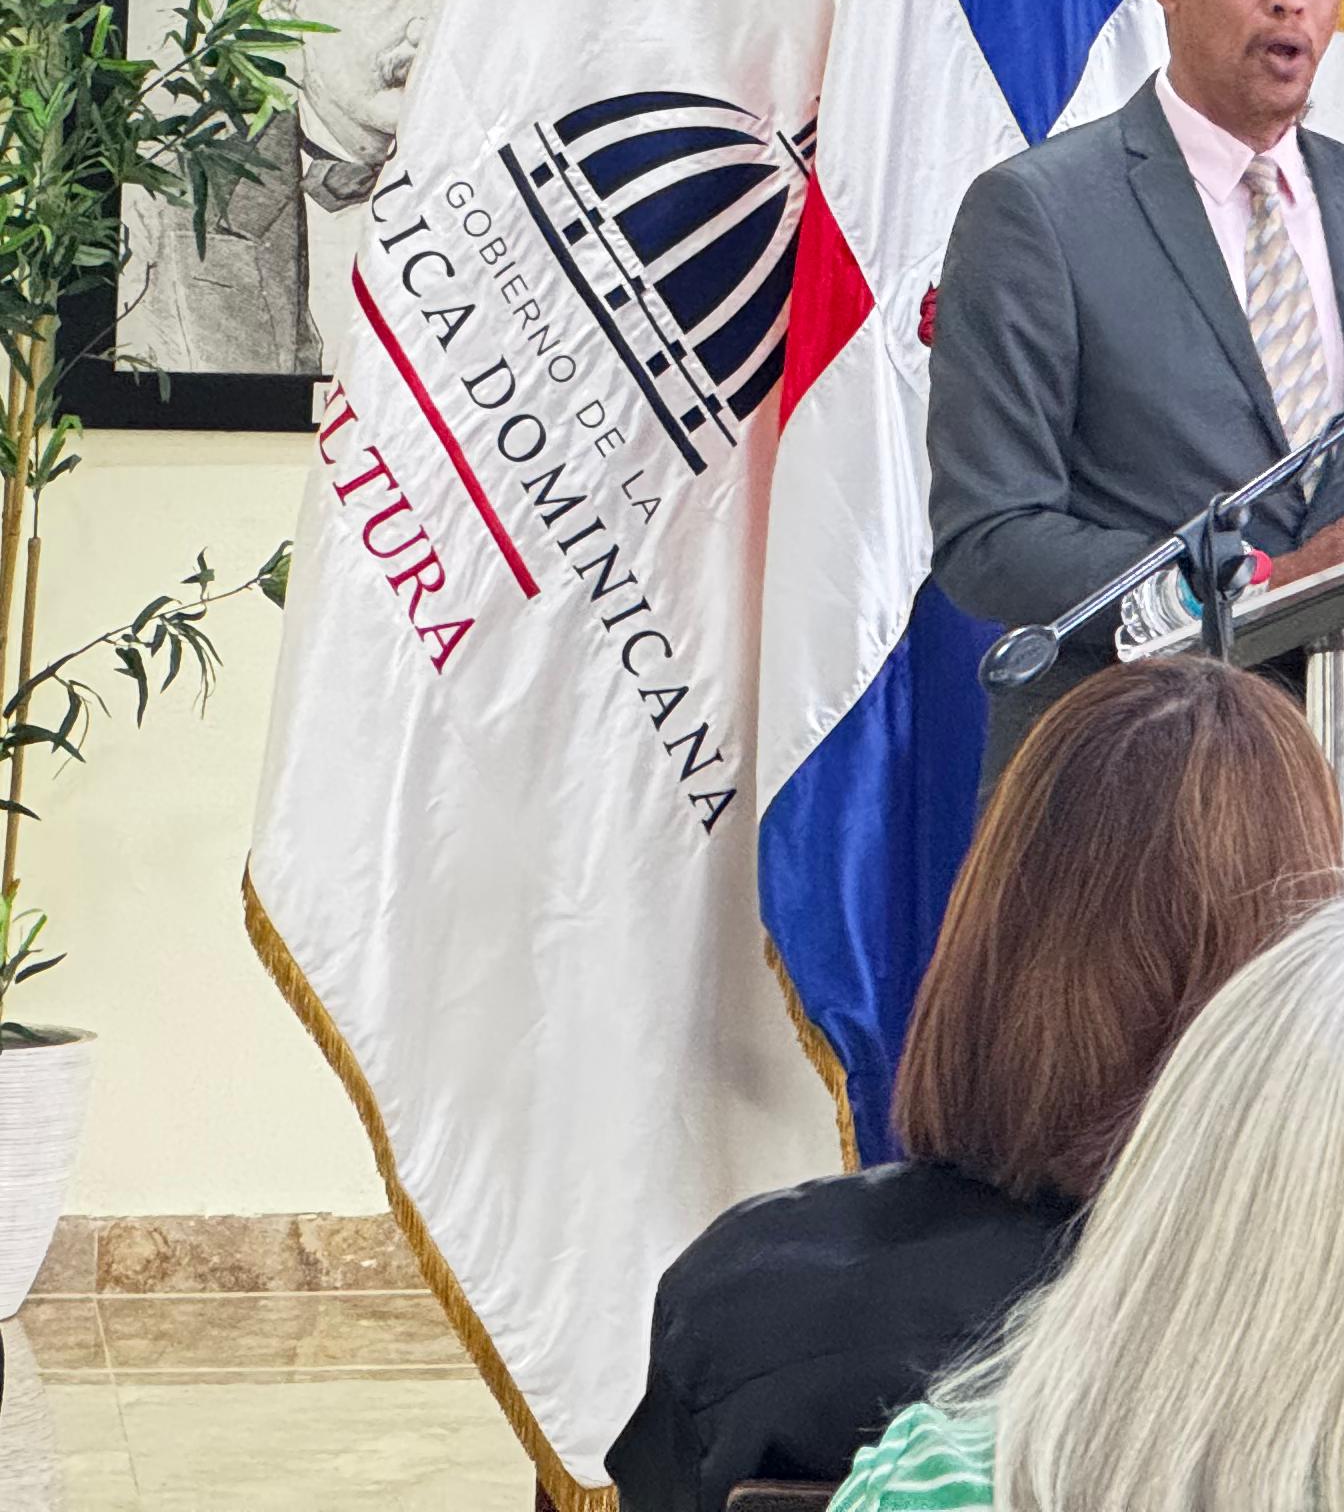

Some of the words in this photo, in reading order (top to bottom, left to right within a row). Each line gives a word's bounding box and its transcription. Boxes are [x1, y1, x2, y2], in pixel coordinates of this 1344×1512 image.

[371, 168, 476, 352] LICA
[462, 359, 738, 835] DOMINICANA
[446, 181, 578, 384] GOBIERNO
[575, 399, 626, 458] DE
[621, 469, 662, 525] LA
